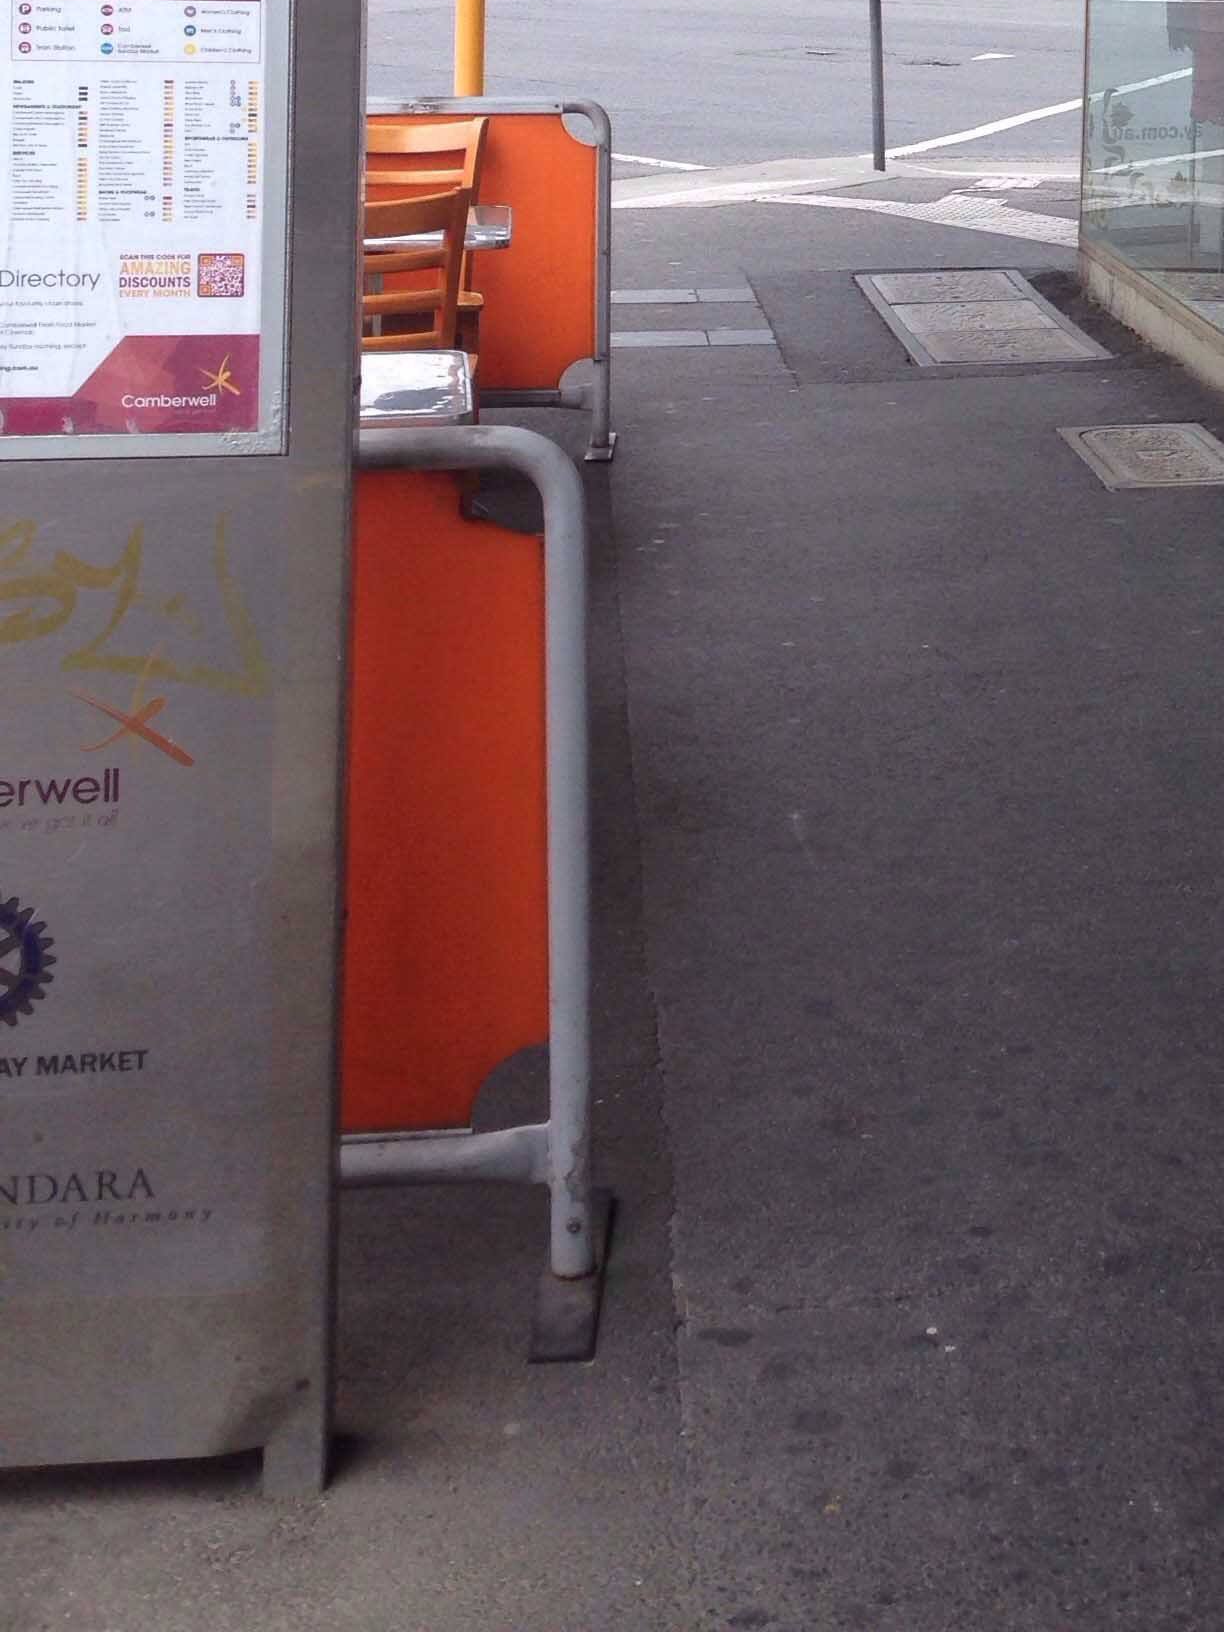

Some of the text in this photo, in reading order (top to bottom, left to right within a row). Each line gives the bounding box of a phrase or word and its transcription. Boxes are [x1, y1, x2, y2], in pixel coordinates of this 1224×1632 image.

[121, 261, 191, 276] AMAZING
[0, 268, 101, 291] Directory
[119, 276, 191, 288] DISCOUNTS
[120, 288, 191, 298] EVERY MONTH
[121, 393, 216, 408] Camberwell
[37, 1049, 149, 1076] MARKET
